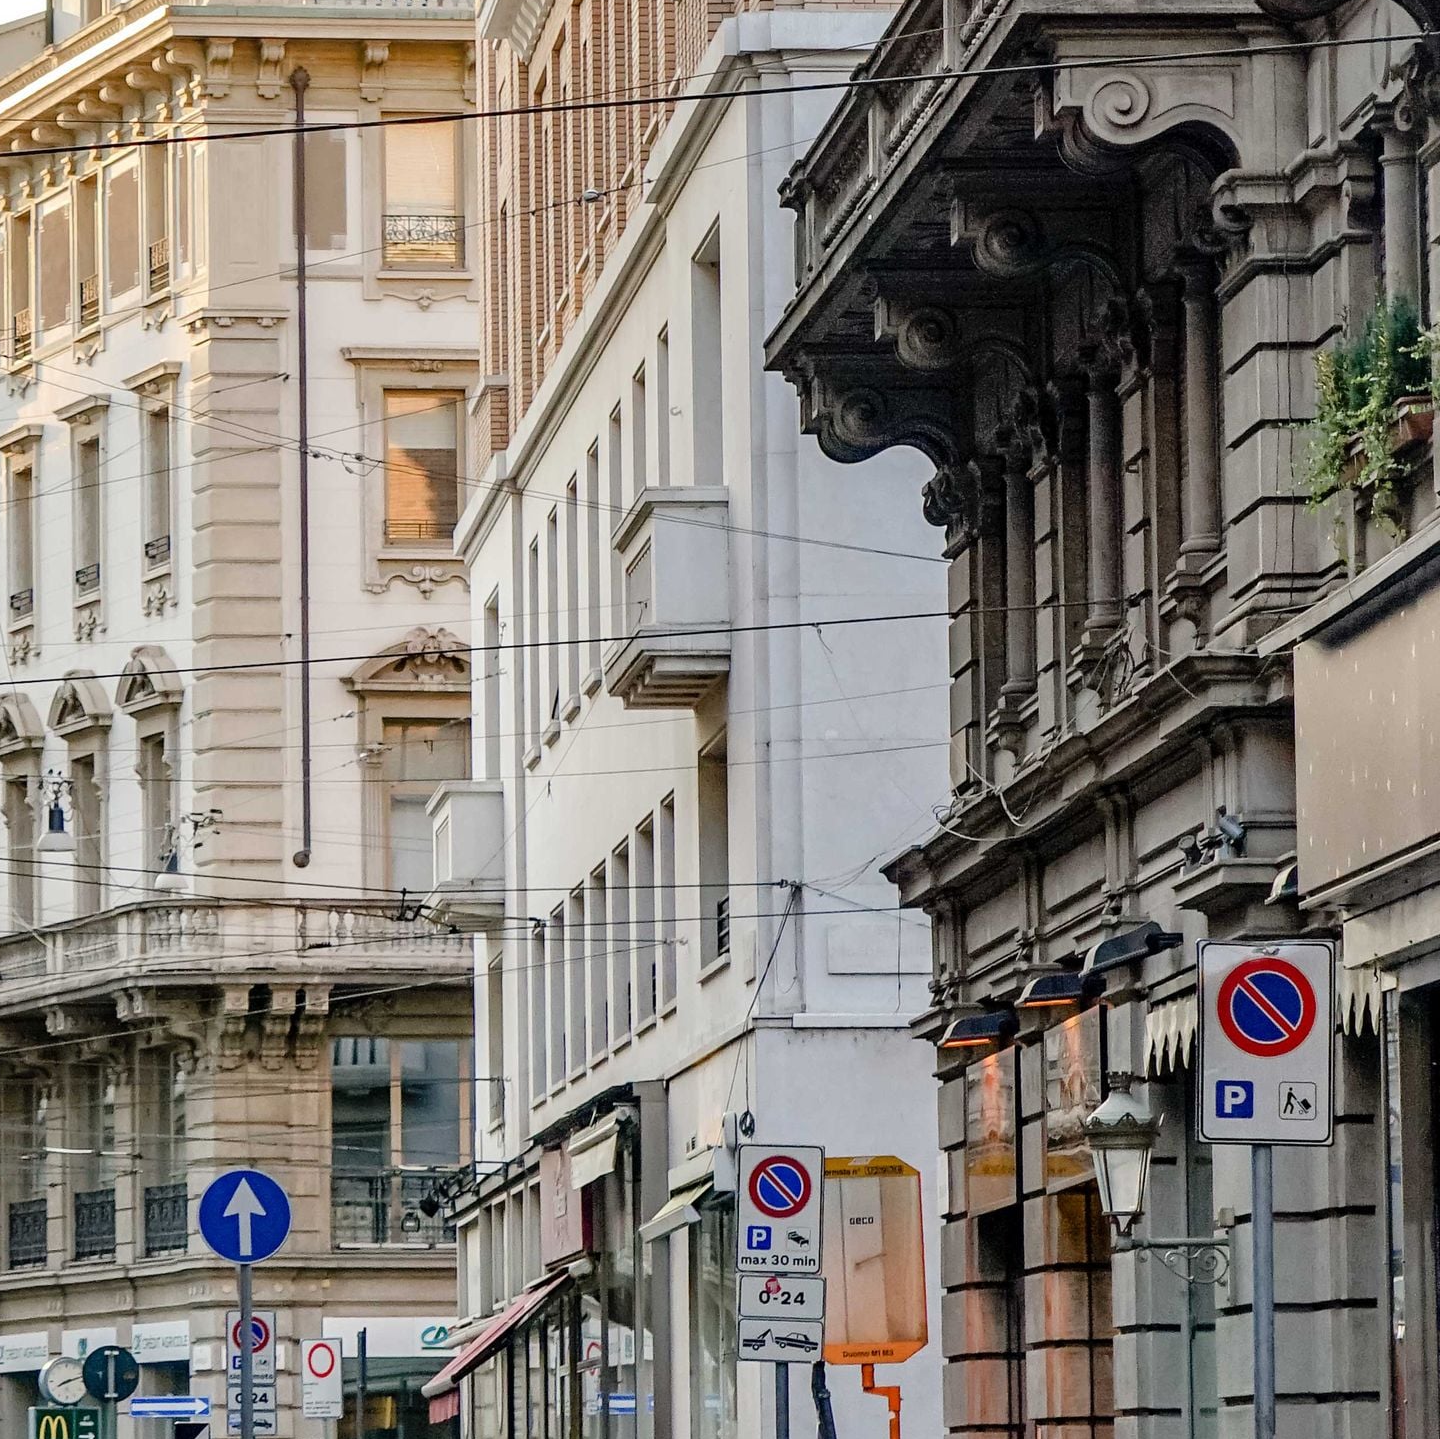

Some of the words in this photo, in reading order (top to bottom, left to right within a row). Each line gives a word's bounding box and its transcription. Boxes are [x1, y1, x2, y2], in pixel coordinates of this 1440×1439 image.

[1223, 1085, 1247, 1114] P
[752, 1229, 767, 1248] P
[741, 1256, 767, 1265] max
[771, 1255, 789, 1266] 30
[792, 1256, 816, 1267] min
[759, 1290, 805, 1305] 0-24
